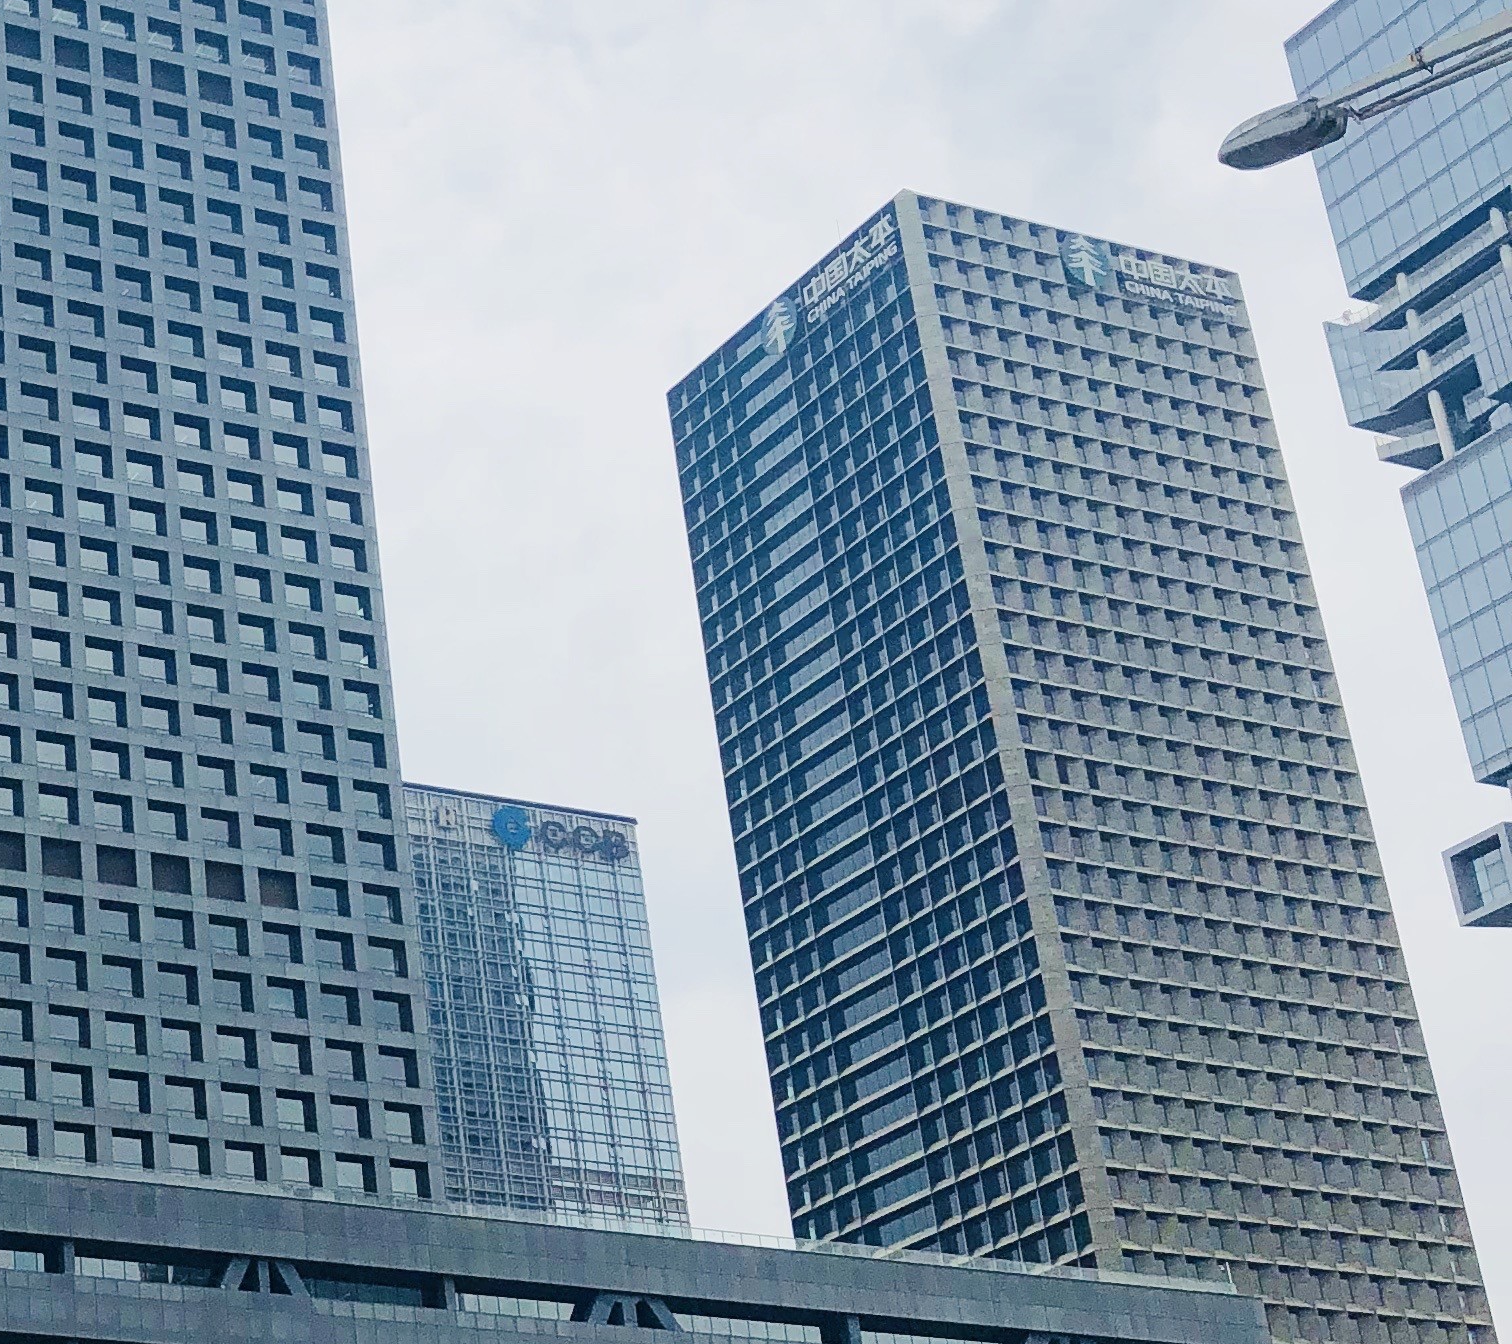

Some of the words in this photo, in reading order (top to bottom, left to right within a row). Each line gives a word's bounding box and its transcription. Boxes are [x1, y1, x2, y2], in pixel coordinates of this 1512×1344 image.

[808, 286, 846, 323] CHINA
[846, 240, 898, 290] TAIPING
[1124, 280, 1174, 304] CHINA
[1174, 292, 1237, 317] TAIPING
